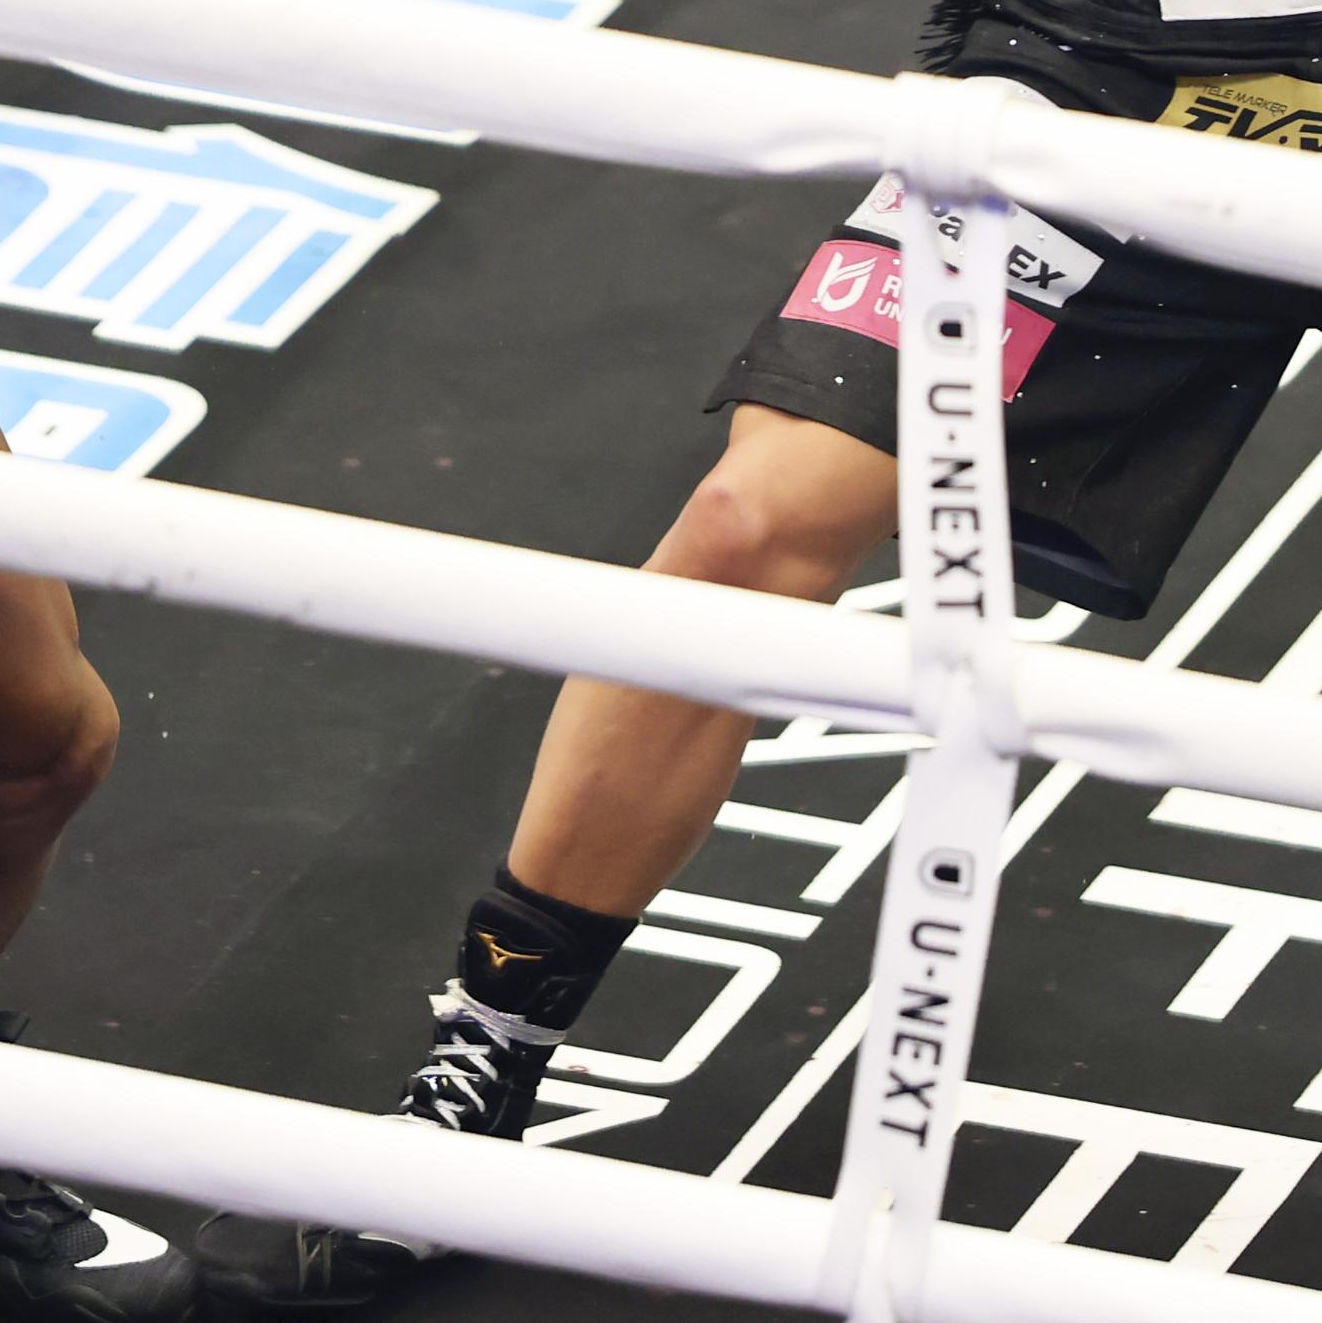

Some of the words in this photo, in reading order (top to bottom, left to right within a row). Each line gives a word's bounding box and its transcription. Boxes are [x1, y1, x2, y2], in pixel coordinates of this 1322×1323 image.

[1201, 84, 1233, 101] TELE
[1234, 91, 1289, 117] MARKER
[927, 381, 986, 620] U-NEXT
[878, 920, 964, 1151] U-NEXT
